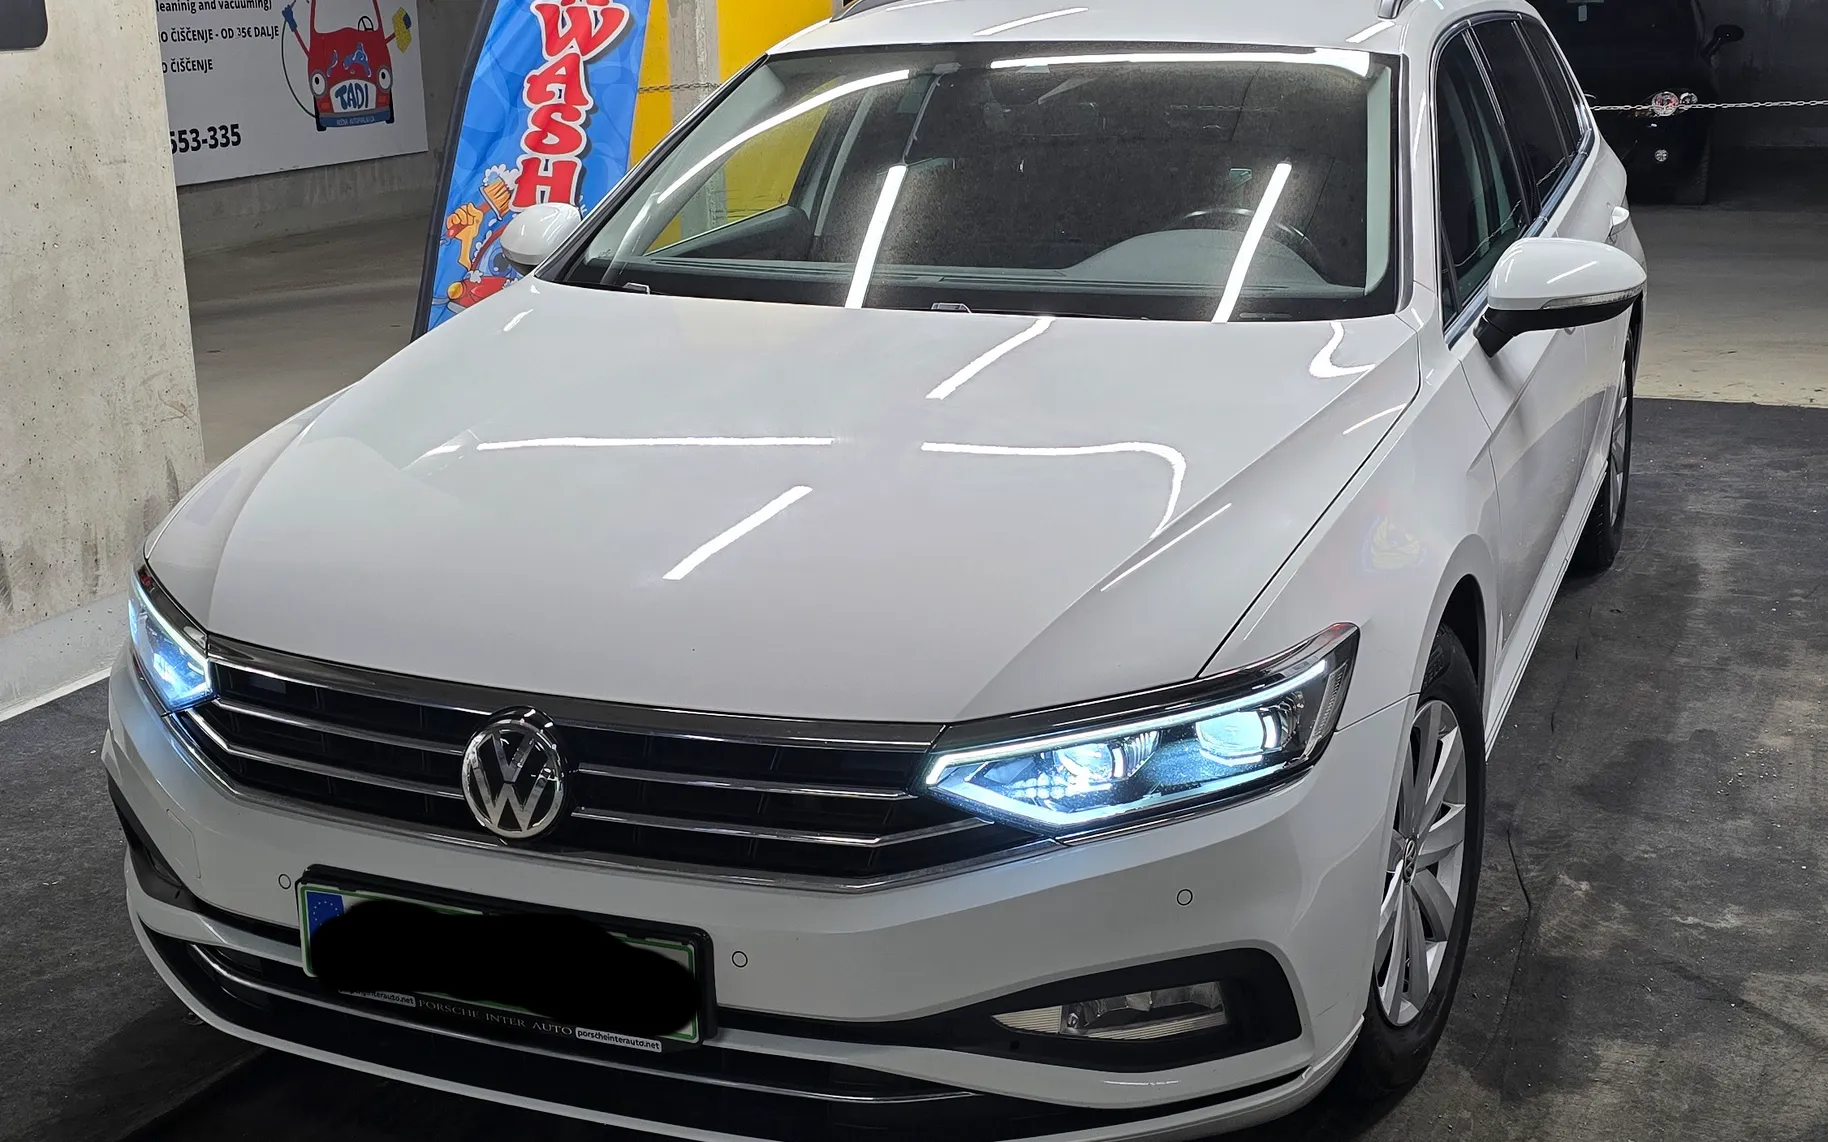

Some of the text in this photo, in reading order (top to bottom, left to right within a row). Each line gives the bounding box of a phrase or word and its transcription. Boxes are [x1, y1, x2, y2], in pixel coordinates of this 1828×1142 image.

[198, 0, 217, 10] and
[171, 26, 214, 44] ČIŠČENJE
[220, 28, 234, 39] OD
[236, 26, 252, 38] 35€
[254, 25, 279, 40] DALJE
[171, 57, 214, 74] ČIŠČENJE
[334, 82, 369, 110] TADI
[418, 999, 573, 1036] PORSCHE INTER AUTO
[577, 1029, 660, 1050] porscheinterauto.net
